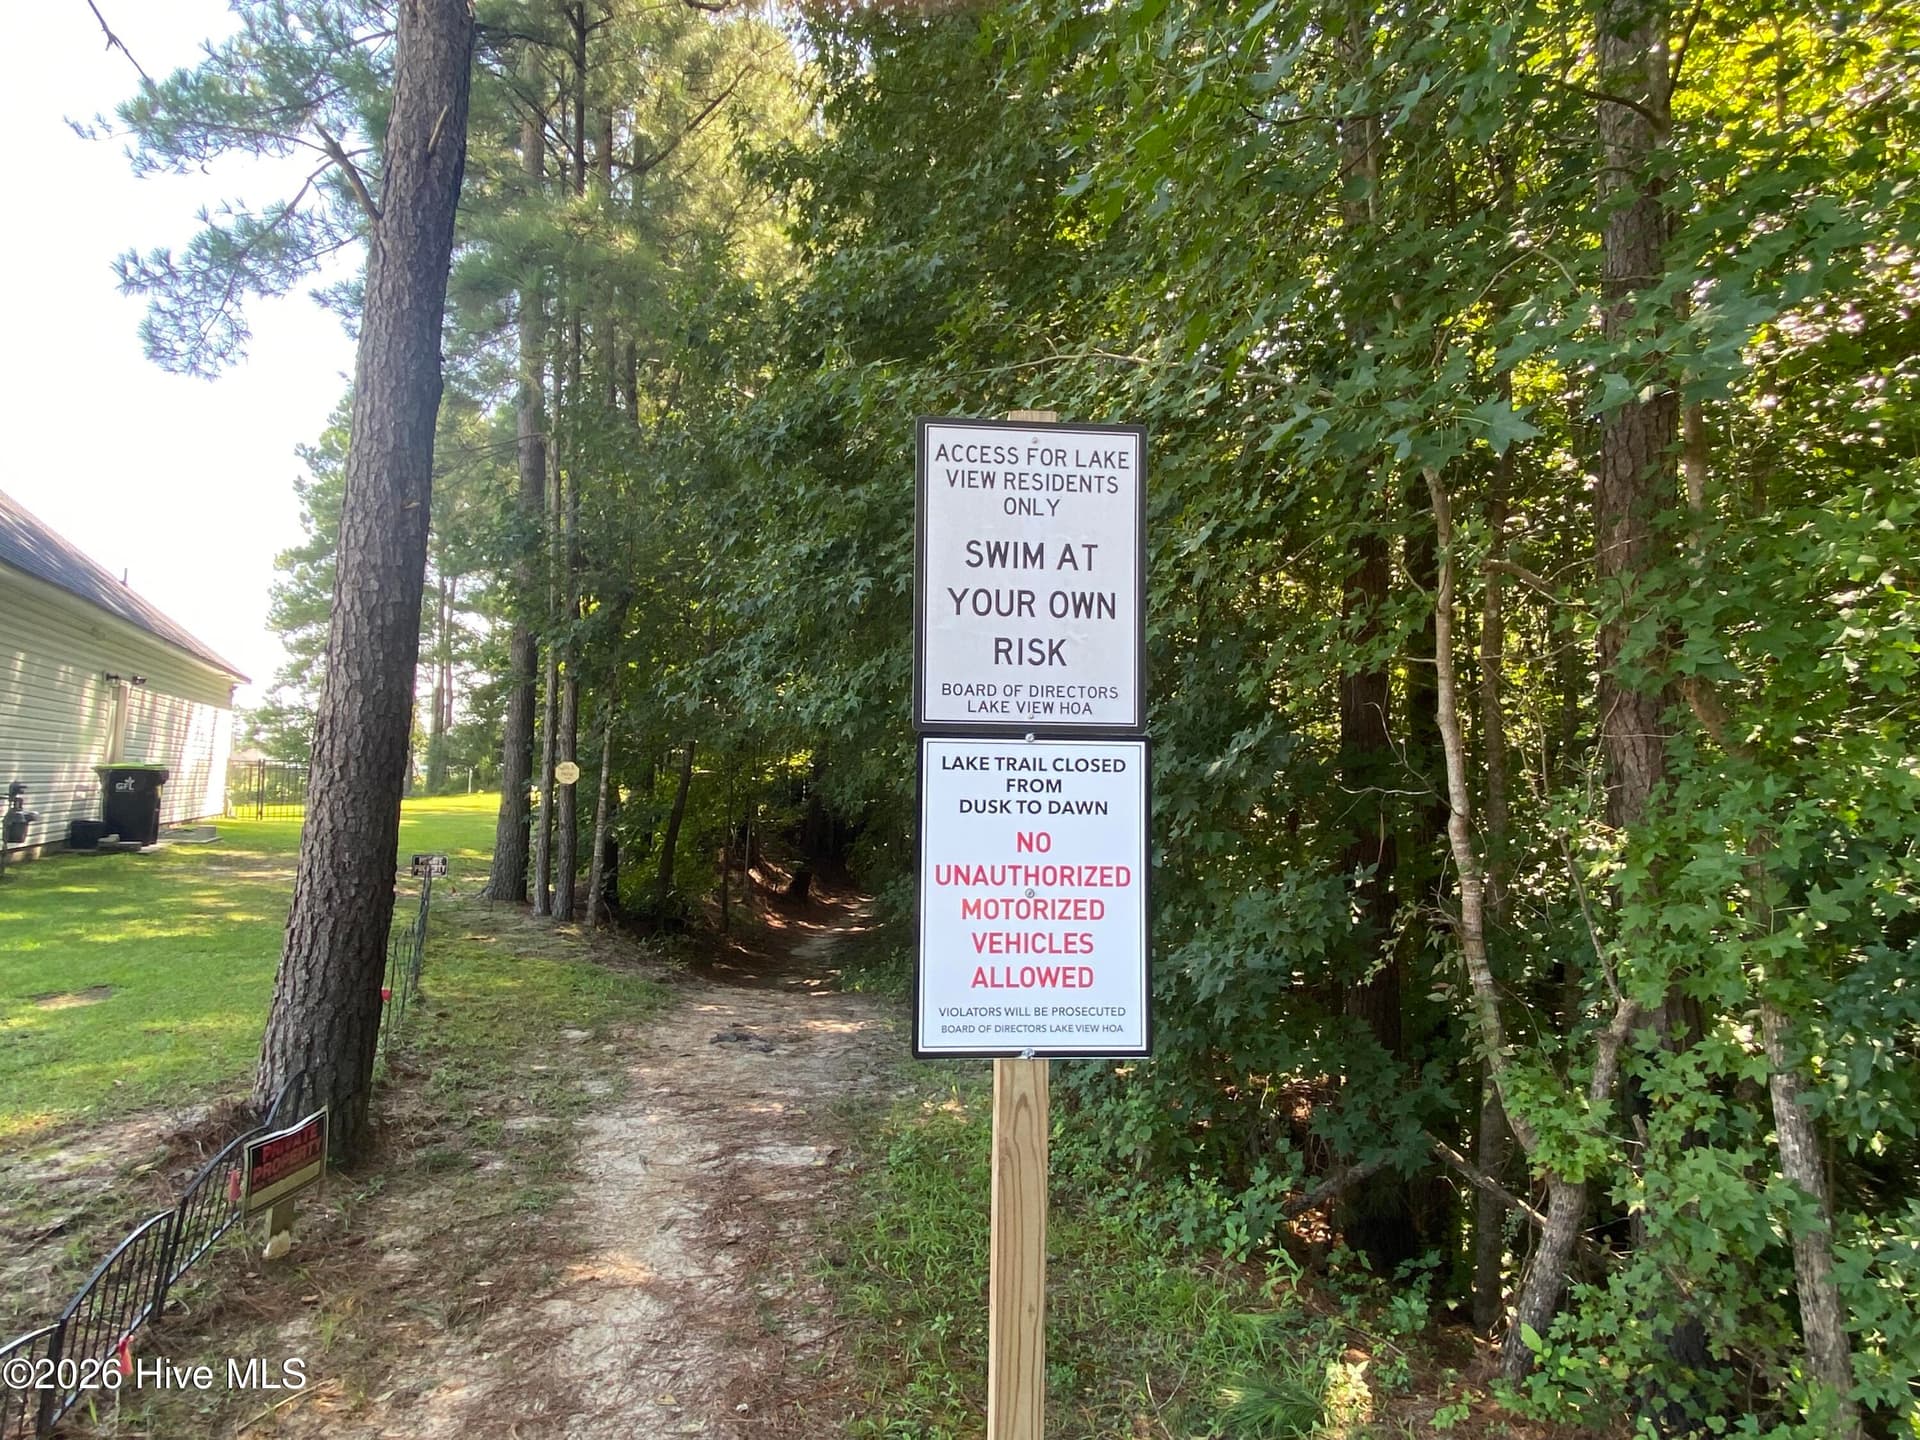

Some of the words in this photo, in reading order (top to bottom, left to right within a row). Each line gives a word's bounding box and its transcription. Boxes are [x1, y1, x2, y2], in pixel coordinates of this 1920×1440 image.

[936, 444, 1018, 465] ACCESS
[1027, 448, 1066, 467] FOR
[1076, 450, 1129, 469] LAKE
[946, 469, 995, 489] VIEW
[1004, 472, 1118, 493] RESIDENTS
[1004, 497, 1060, 516] ONLY
[965, 540, 1044, 569] SWIM
[1056, 544, 1098, 571] AT
[947, 588, 1035, 617] YOUR
[1050, 591, 1115, 619] OWN
[994, 637, 1067, 666] RISK
[942, 683, 996, 697] BOARD
[1003, 685, 1022, 697] OF
[1029, 686, 1118, 699] DIRECTORS
[968, 700, 1009, 713] LAKE
[1016, 701, 1054, 714] VIEW
[1060, 703, 1092, 715] HOA
[942, 756, 989, 771] LAKE
[995, 757, 1047, 772] TRAIL
[1053, 758, 1126, 773] CLOSED
[1006, 779, 1062, 793] FROM
[960, 800, 1010, 814] DUSK
[1016, 800, 1042, 815] TO
[1048, 801, 1108, 815] DAWN
[1017, 832, 1050, 853] NO
[936, 865, 1130, 887] UNAUTHORIZED
[962, 899, 1105, 920] MOTORIZED
[971, 932, 1094, 954] VEHICLES
[971, 967, 1094, 988] ALLOWED
[939, 1007, 1002, 1017] VIOLATORS
[1004, 1007, 1031, 1017] WILL
[1034, 1007, 1048, 1017] BE
[1052, 1007, 1126, 1017] PROSECUTED
[941, 1024, 975, 1033] BOARD
[979, 1025, 991, 1033] OF
[994, 1024, 1047, 1033] DIRECTORS
[1050, 1025, 1074, 1033] LAKE
[1076, 1025, 1099, 1033] VIEW
[1102, 1024, 1123, 1033] HOA
[262, 1122, 318, 1163] PRIVATE
[253, 1136, 322, 1184] PROPERTY
